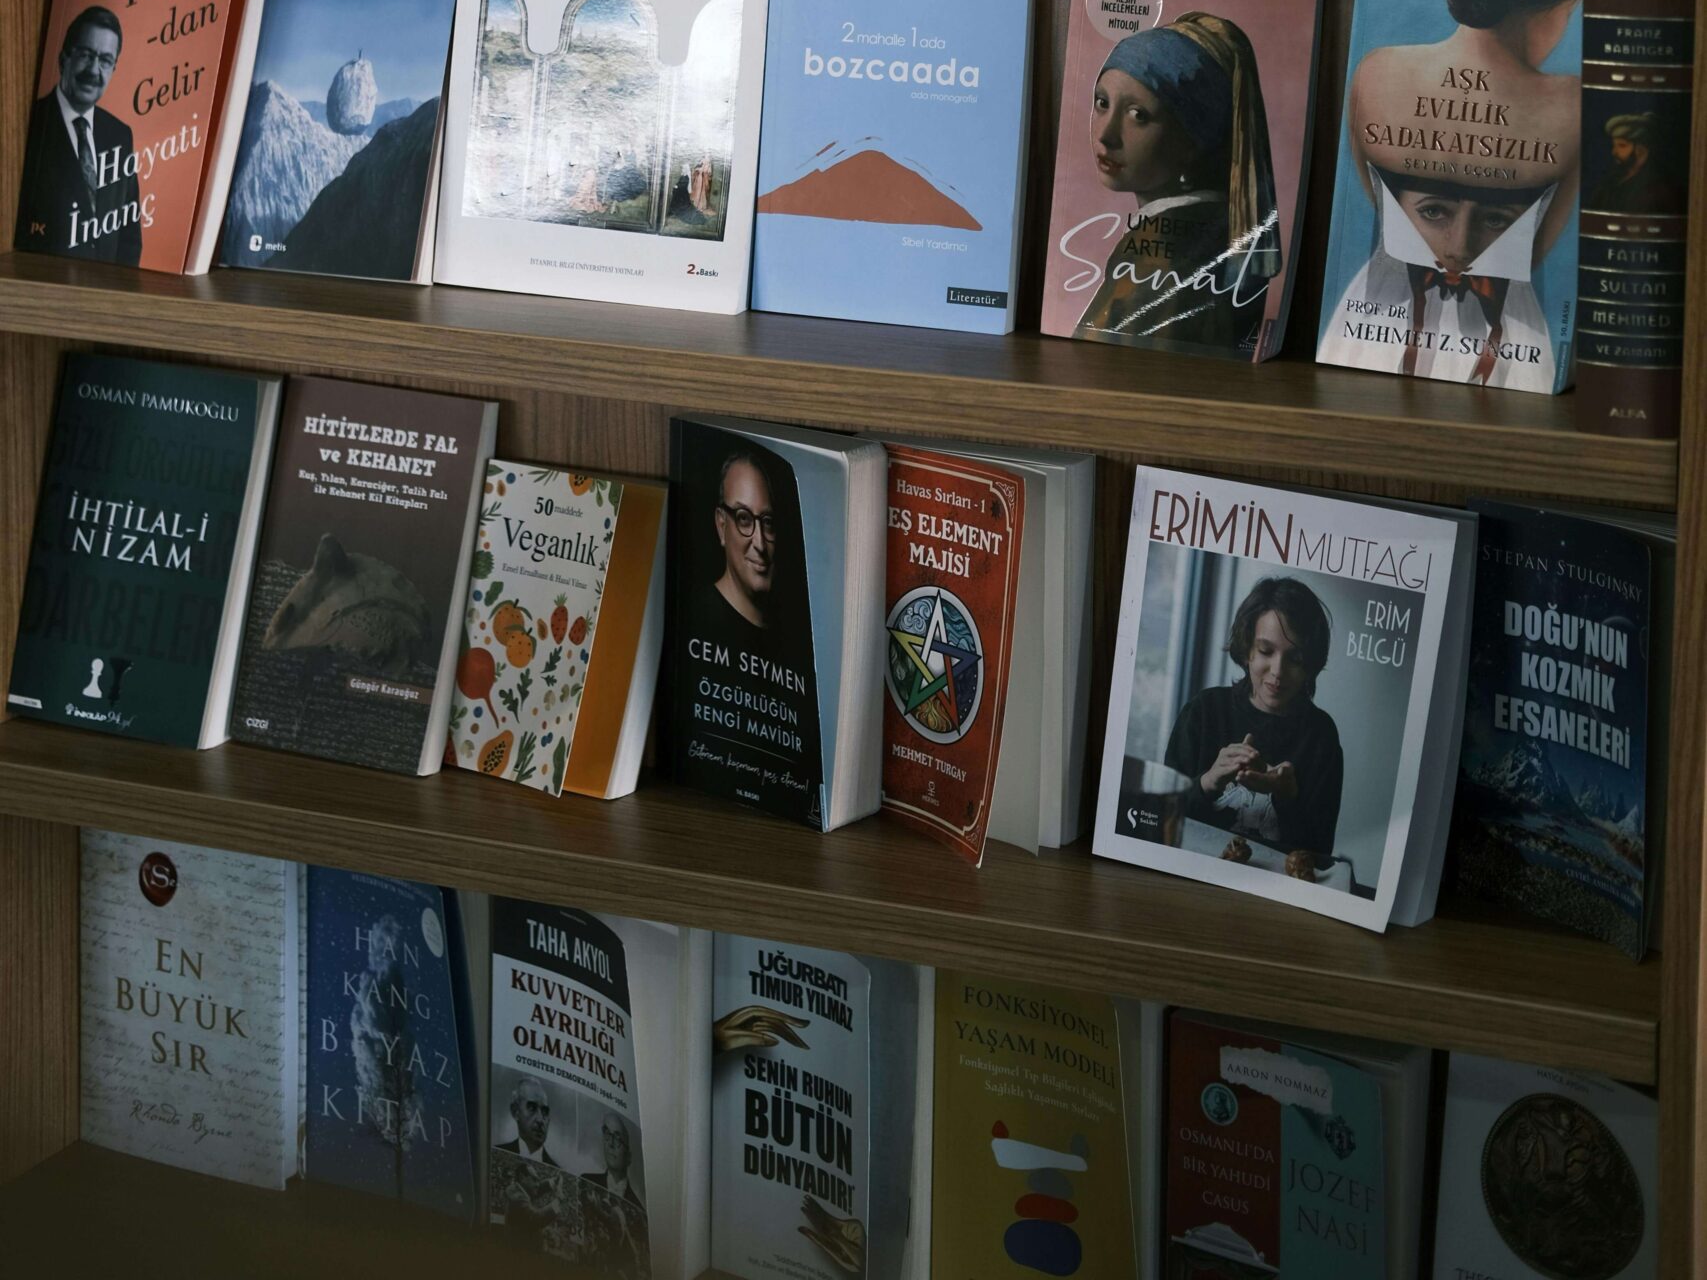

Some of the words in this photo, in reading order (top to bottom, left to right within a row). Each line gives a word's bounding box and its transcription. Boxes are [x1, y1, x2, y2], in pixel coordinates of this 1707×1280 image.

[147, 2, 219, 45] -dan
[1101, 0, 1150, 16] İNCELEMELERİ
[1108, 17, 1140, 33] MİTOLOJİ
[841, 21, 855, 43] 2
[857, 33, 906, 47] mahalle
[911, 26, 917, 48] 1
[919, 37, 946, 50] ada
[1616, 28, 1662, 39] FRANZ
[132, 61, 206, 116] Gelir
[804, 47, 980, 88] bozcaada
[1440, 67, 1492, 94] AŞK
[1414, 96, 1510, 126] EVLİLİK
[96, 112, 201, 189] Hayati
[1365, 123, 1559, 165] SADAKATSİZLİK
[68, 192, 156, 249] İnanç
[902, 236, 924, 248] Sibel
[265, 242, 287, 252] metis
[1059, 213, 1279, 308] Sanat
[950, 290, 997, 305] Literatür
[1346, 299, 1383, 317] PROF.
[1388, 304, 1409, 319] DR.
[1344, 322, 1437, 349] MEHMET
[1439, 334, 1454, 352] Z.
[1459, 336, 1542, 364] SUNGUR
[78, 383, 136, 405] OSMAN
[141, 392, 239, 422] PAMUKOĞLU
[304, 413, 419, 449] HİTİTLERDE
[423, 433, 459, 455] FAL
[320, 448, 341, 463] ve
[347, 448, 436, 477] KEHANET
[534, 497, 554, 516] 50
[896, 479, 932, 500] Havas
[935, 487, 971, 509] Sırları
[68, 490, 208, 542] İHTİLAL-İ
[918, 512, 1003, 555] ELEMENT
[71, 526, 192, 572] NİZAM
[503, 517, 599, 567] Veganlık
[909, 542, 970, 578] MAJİSİ
[1297, 529, 1432, 592] MUTFAĞI
[1482, 545, 1549, 572] STEPAN
[1365, 600, 1411, 634] ERİM
[688, 638, 730, 668] CEM
[739, 651, 806, 696] SEYMEN
[1346, 631, 1406, 668] BELGÜ
[699, 676, 798, 727] ÖZGÜRLÜĞÜN
[1521, 651, 1616, 714] KOZMİK
[694, 702, 741, 730] RENGİ
[746, 720, 803, 753] MAVİDİR
[1494, 693, 1631, 770] EFSANELERİ
[892, 743, 933, 768] MEHMET
[935, 758, 967, 783] TURGAY
[155, 938, 204, 981] EN
[355, 926, 420, 969] HAN
[526, 918, 569, 961] TAHA
[573, 937, 614, 984] AKYOL
[343, 971, 430, 1020] KANG
[758, 950, 848, 1001] UĞURBATI
[116, 976, 249, 1039] BÜYÜK
[511, 968, 626, 1039] KUVVETLER
[749, 970, 804, 1009] TİMUR
[805, 987, 854, 1033] YILMAZ
[963, 985, 1109, 1049] FONKSİYONEL
[530, 1003, 616, 1057] AYRILIĞI
[151, 1031, 212, 1076] SIR
[513, 1025, 628, 1093] OLMAYINCA
[955, 1021, 1035, 1055] YAŞAM
[1044, 1041, 1116, 1089] MODELİ
[744, 1053, 798, 1092] SENİN
[802, 1071, 853, 1119] RUHUN
[1226, 1063, 1269, 1080] AARON
[1274, 1075, 1328, 1099] NOMMAZ
[745, 1088, 853, 1176] BÜTÜN
[1183, 1155, 1208, 1175] BİR
[1210, 1165, 1271, 1192] YAHUDİ
[1288, 1158, 1377, 1214] JOZEF
[1202, 1191, 1249, 1215] CASUS
[1296, 1205, 1367, 1256] NASİ
